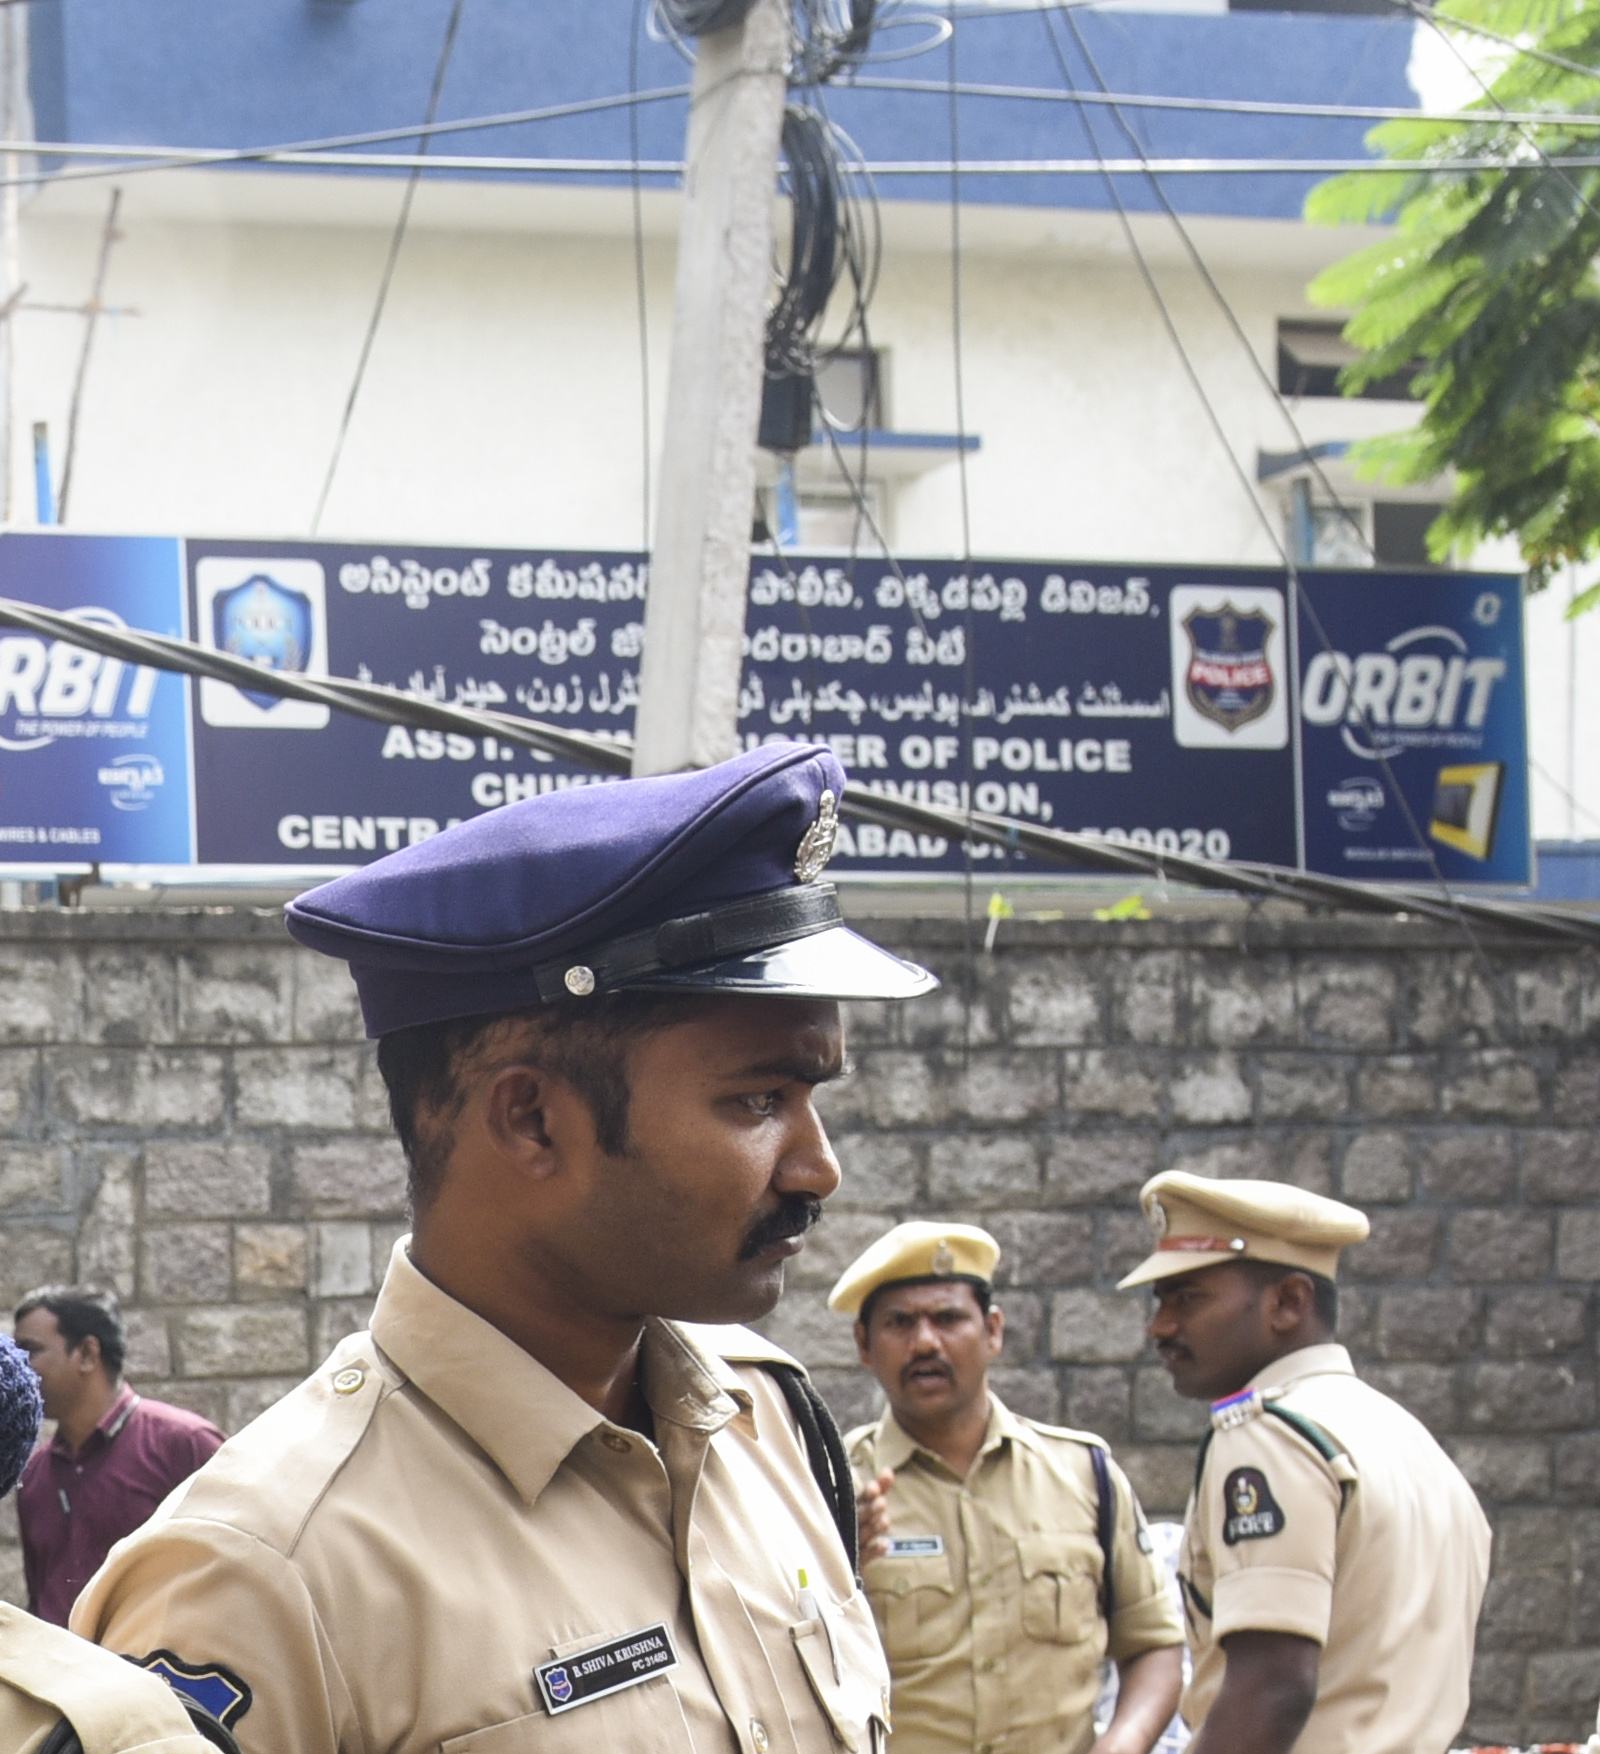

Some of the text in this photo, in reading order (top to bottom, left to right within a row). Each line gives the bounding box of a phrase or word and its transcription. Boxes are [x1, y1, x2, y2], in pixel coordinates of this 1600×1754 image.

[1301, 649, 1507, 728] ORBIT
[901, 735, 960, 769] OF
[972, 736, 1133, 774] POLICE
[582, 1653, 615, 1675] SHIVA
[614, 1635, 664, 1663] KRUSHNA
[631, 1659, 645, 1672] PC
